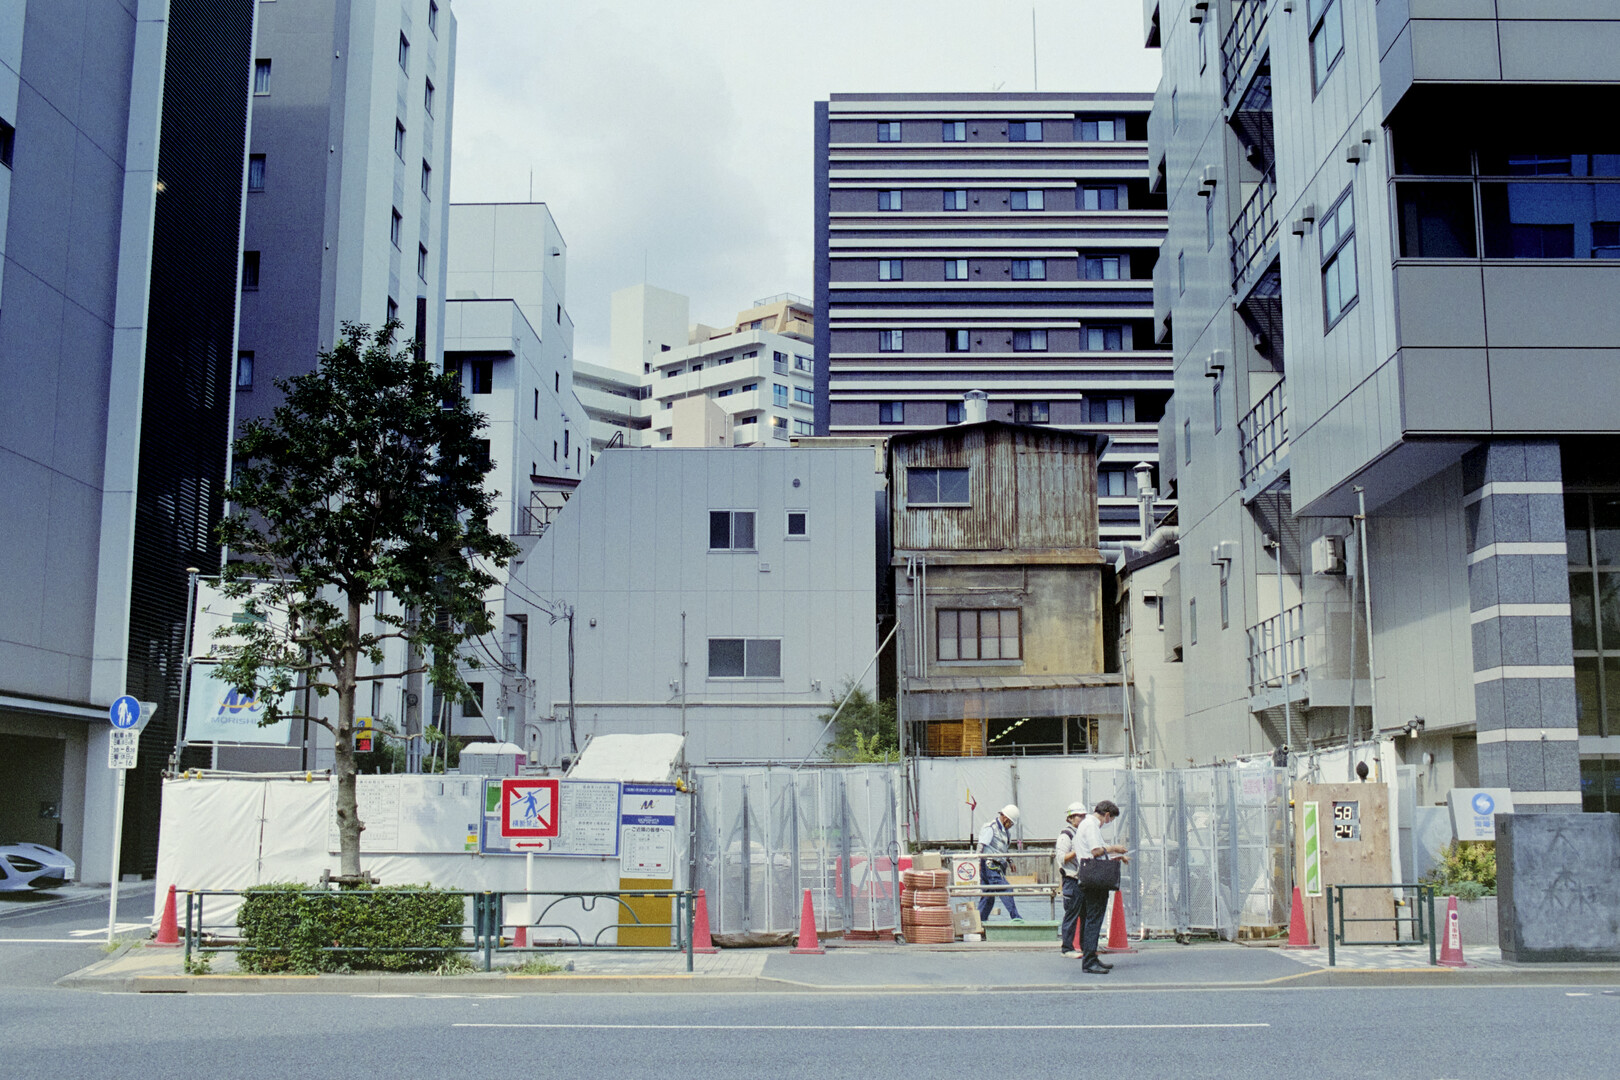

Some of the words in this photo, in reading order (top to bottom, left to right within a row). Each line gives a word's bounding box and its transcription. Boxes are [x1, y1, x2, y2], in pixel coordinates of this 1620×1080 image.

[1335, 806, 1352, 820] 58
[512, 819, 539, 828] 横断禁止
[1335, 825, 1353, 838] 24
